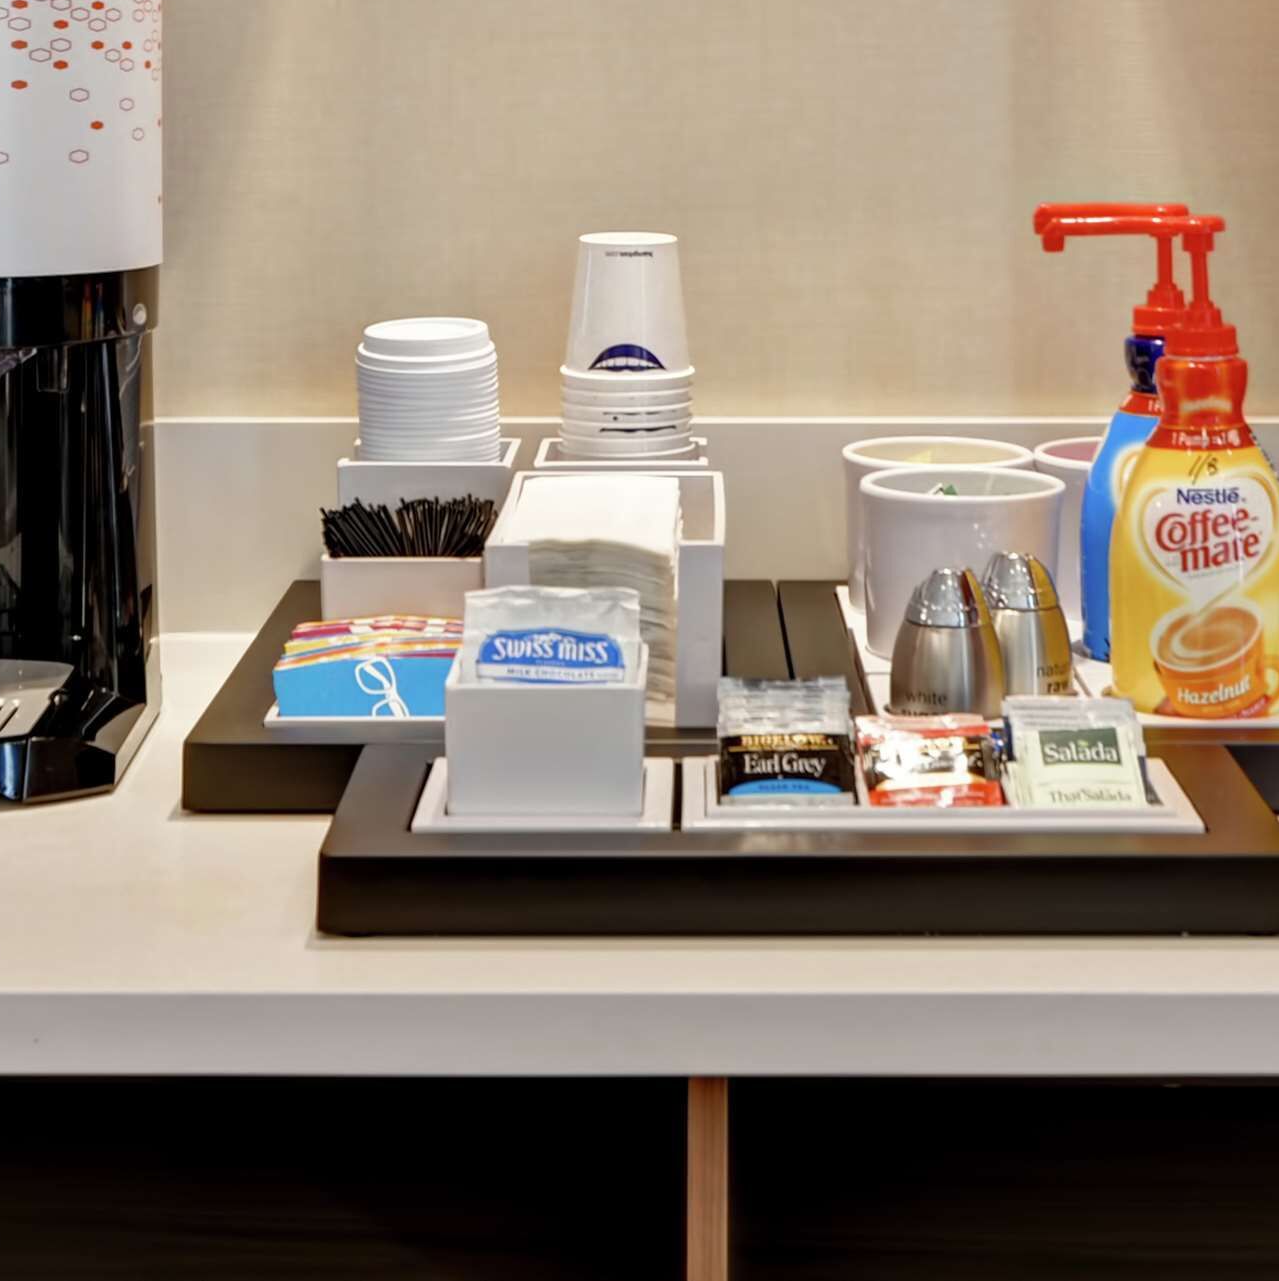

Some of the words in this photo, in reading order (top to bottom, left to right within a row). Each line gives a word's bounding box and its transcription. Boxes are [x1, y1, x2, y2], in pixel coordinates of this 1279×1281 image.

[1177, 673, 1250, 705] Hazelnut
[744, 753, 780, 774] Earl
[782, 752, 826, 778] Grey
